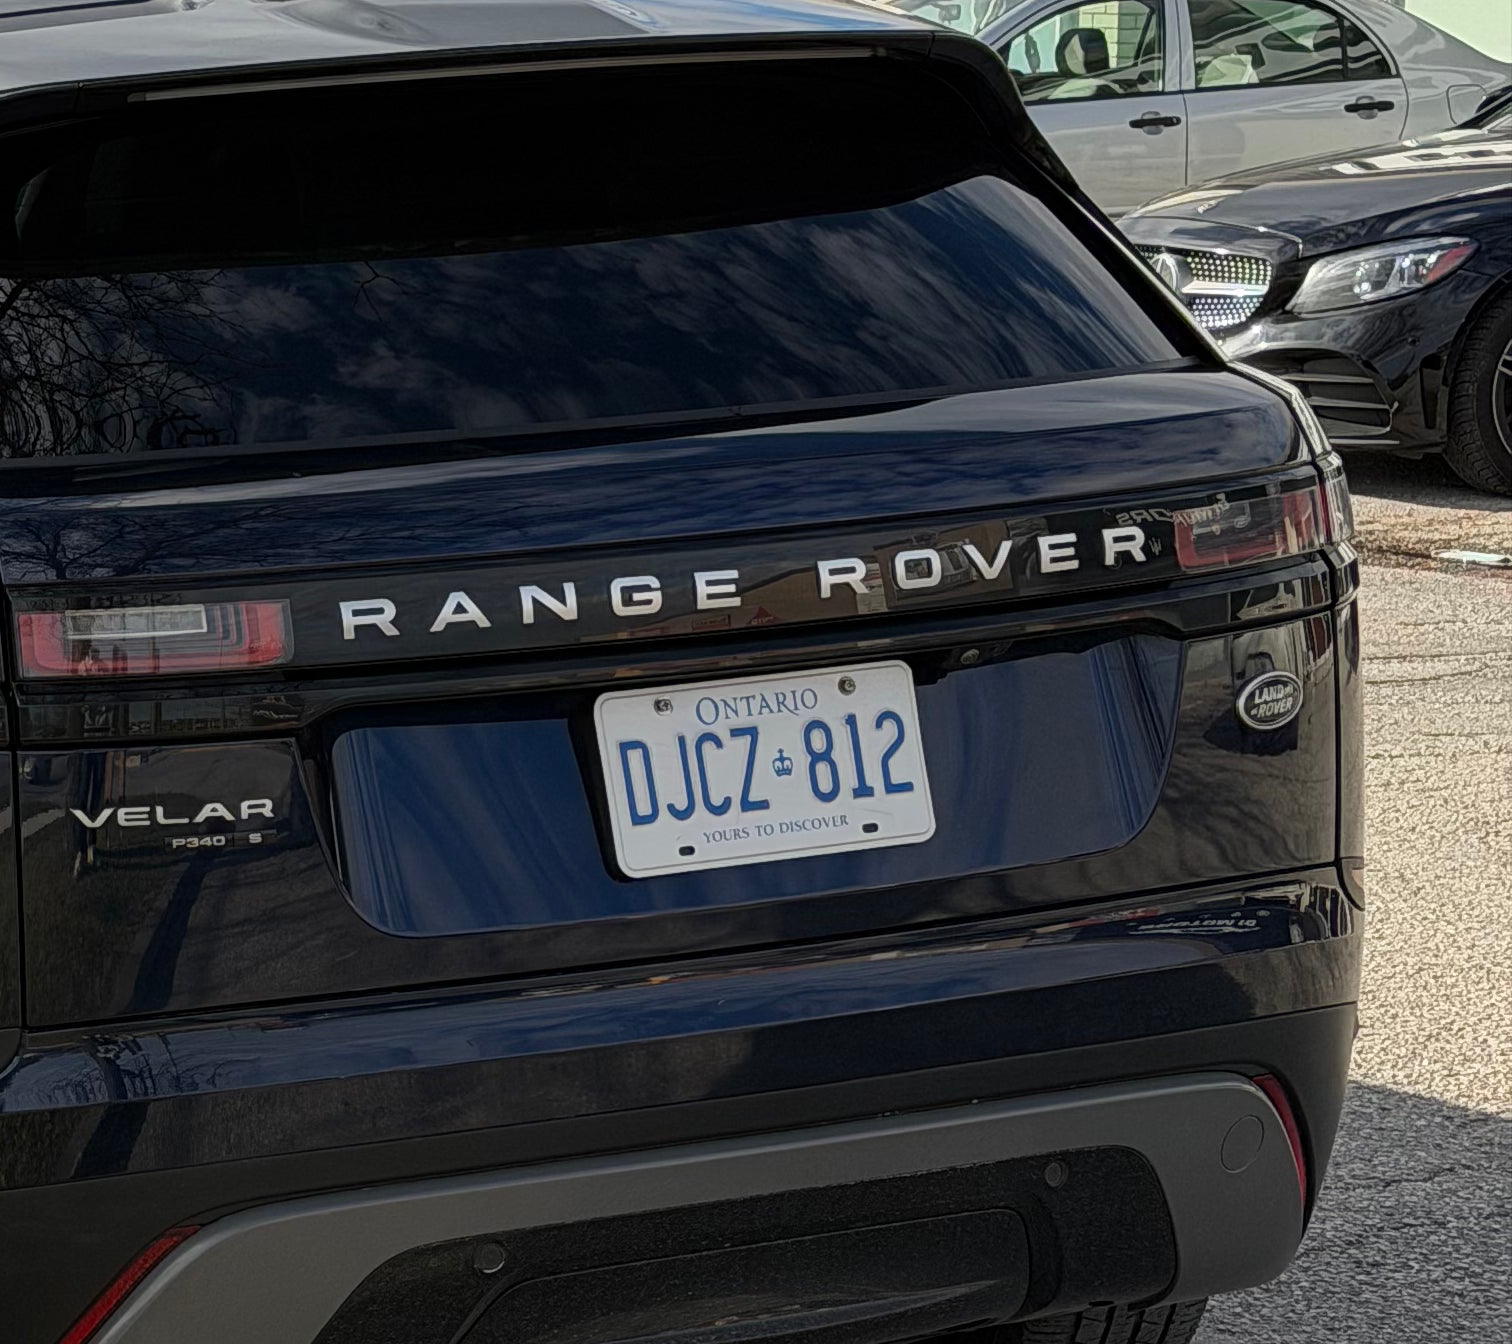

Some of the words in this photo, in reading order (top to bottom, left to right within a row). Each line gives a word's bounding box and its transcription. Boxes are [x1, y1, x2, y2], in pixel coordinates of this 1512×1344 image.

[339, 568, 741, 640] RANGE
[820, 526, 1147, 600] ROVER
[695, 688, 818, 725] ONTARIO
[1254, 684, 1285, 704] LAND
[1257, 697, 1294, 718] ROVER
[619, 726, 770, 826] DJCZ
[803, 710, 914, 803] 812
[69, 798, 275, 828] VELAR
[172, 835, 226, 849] P340
[248, 832, 263, 844] S
[703, 827, 750, 844] YOURS
[754, 824, 773, 836] TO
[779, 814, 849, 835] DISCOVER
